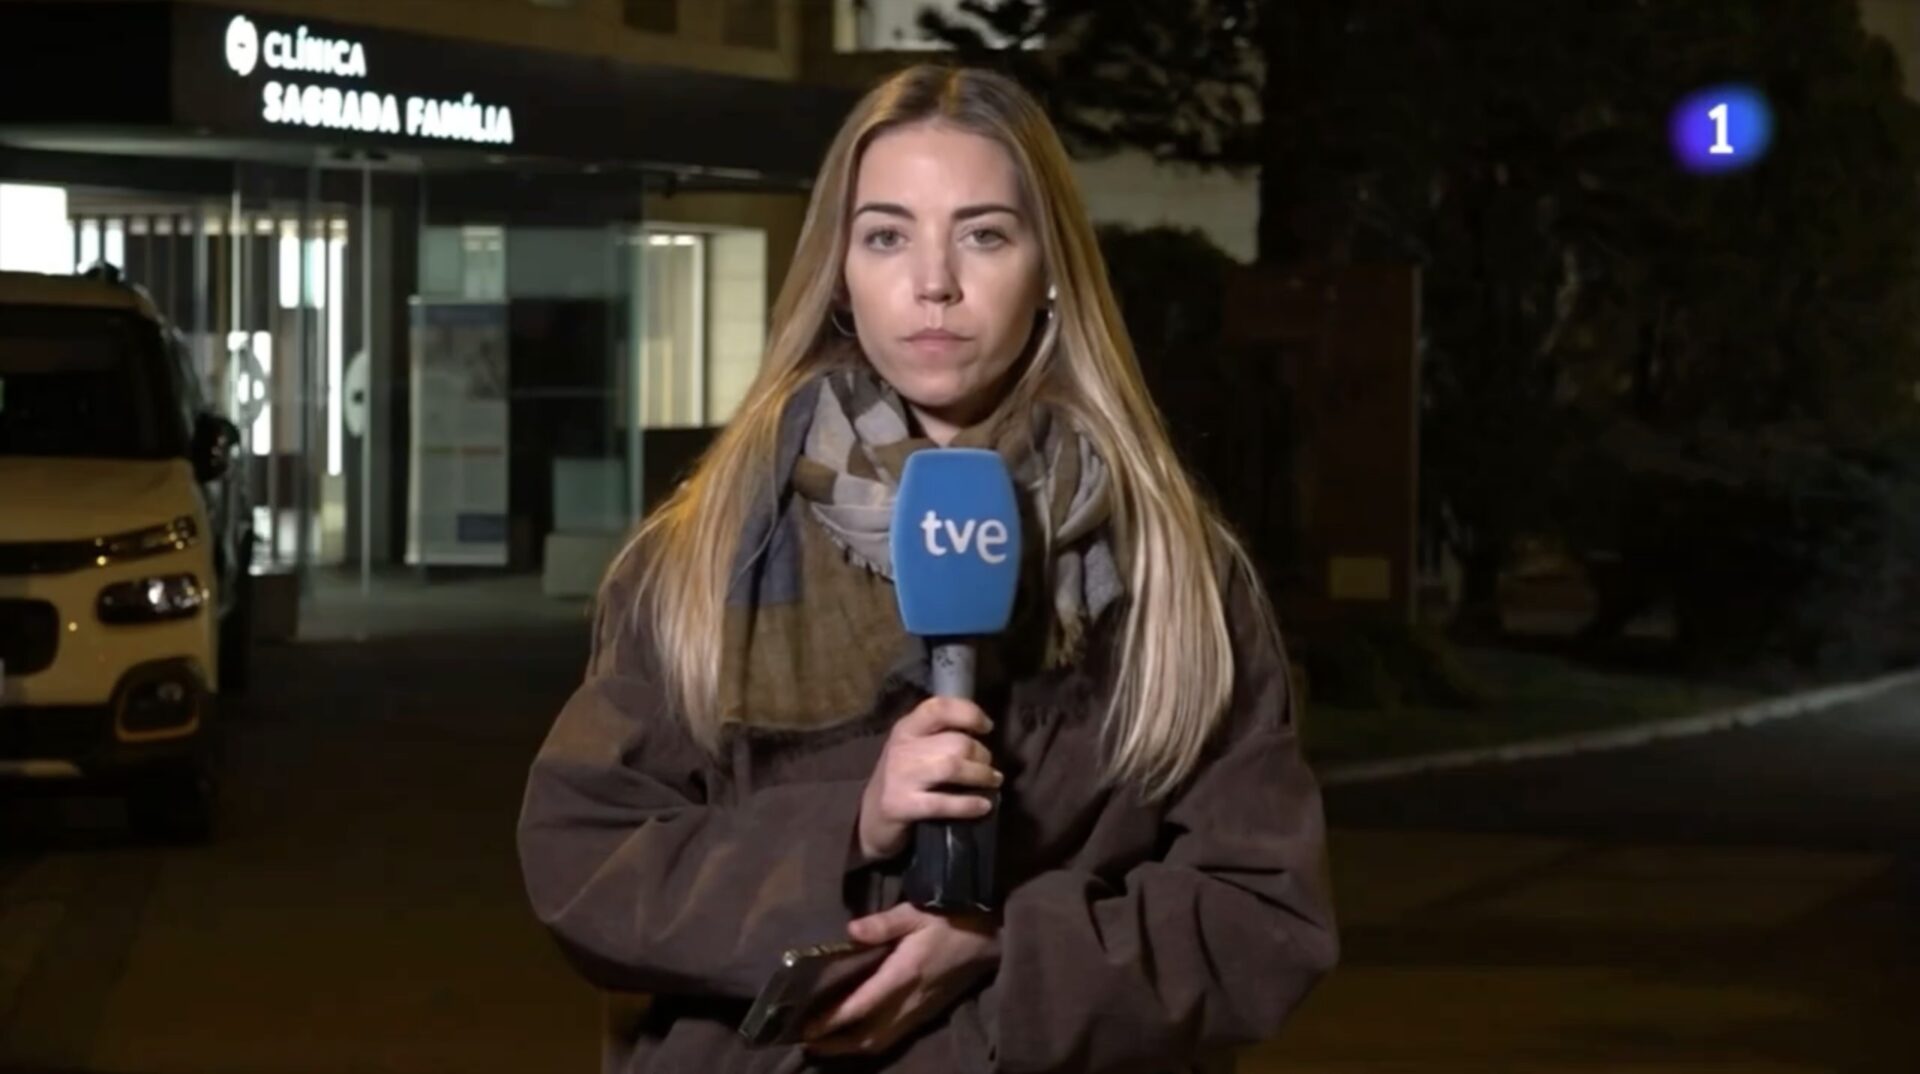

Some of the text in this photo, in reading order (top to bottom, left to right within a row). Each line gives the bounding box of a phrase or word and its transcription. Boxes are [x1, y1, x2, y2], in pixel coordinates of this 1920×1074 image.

[263, 25, 367, 77] CLÍNICA
[262, 81, 514, 144] SAGRADA FAMÍLIA
[920, 509, 1009, 565] tve
